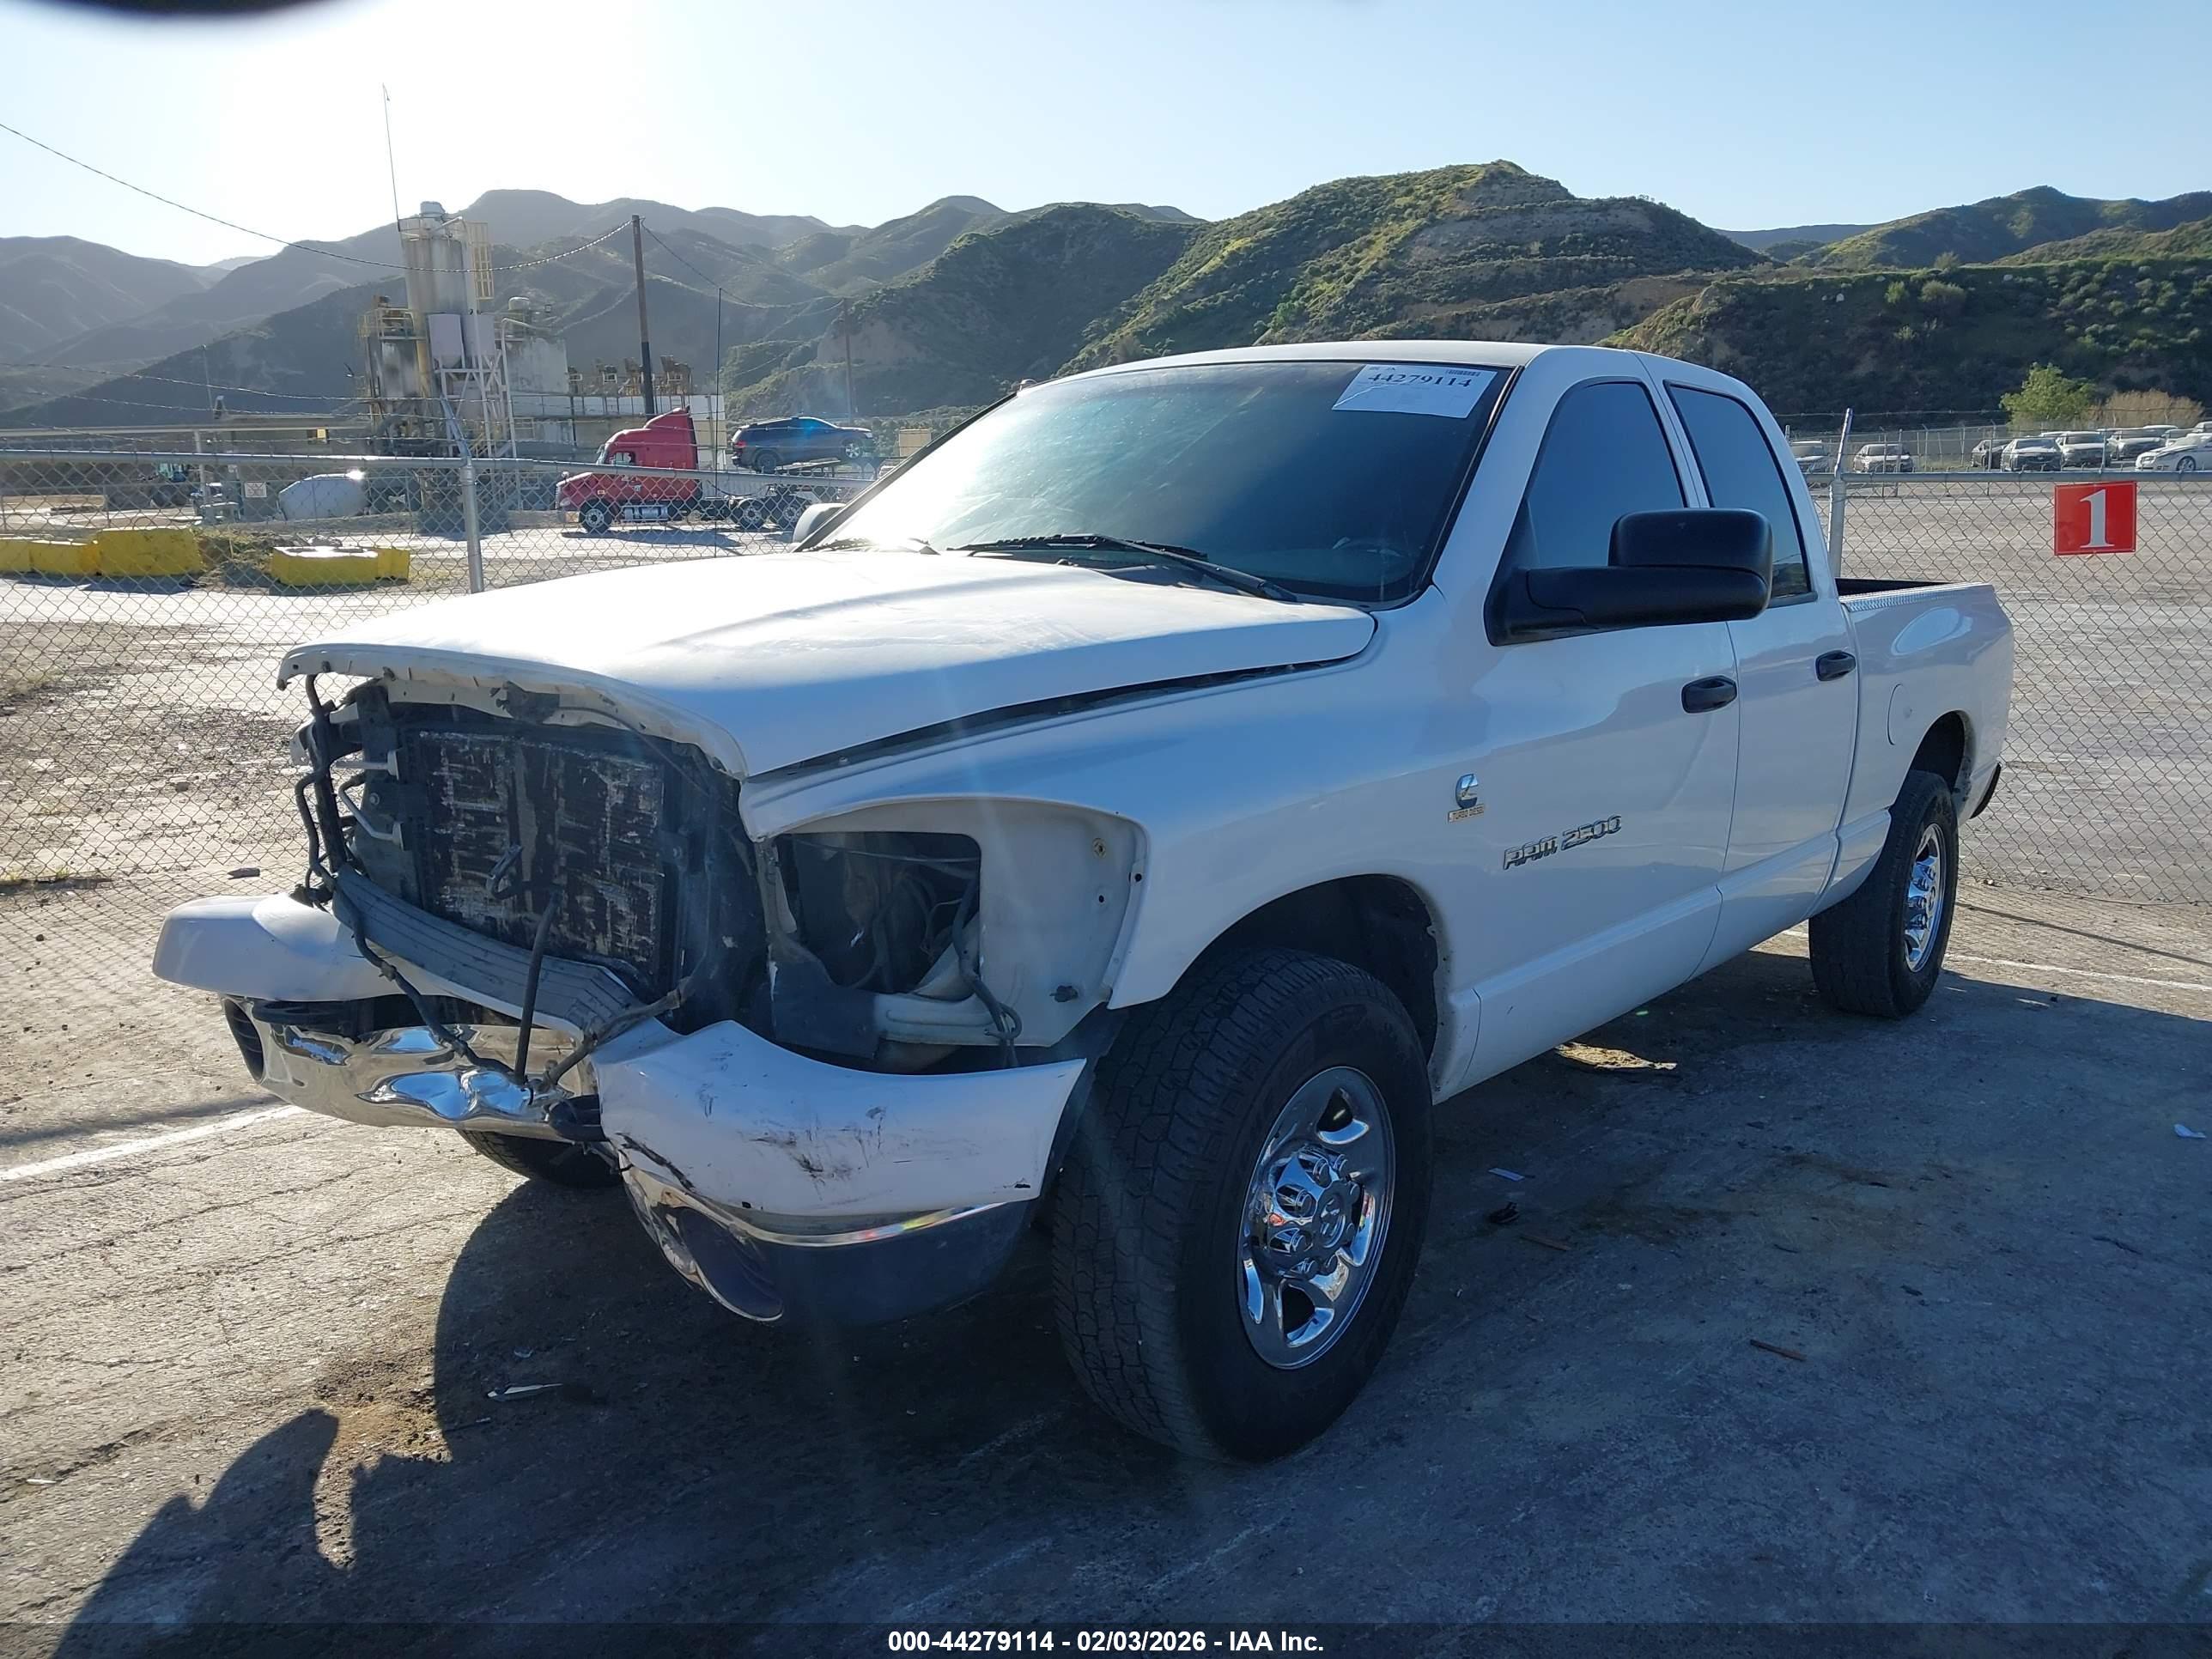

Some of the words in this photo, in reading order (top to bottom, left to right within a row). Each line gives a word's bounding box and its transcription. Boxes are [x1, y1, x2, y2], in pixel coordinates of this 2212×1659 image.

[1367, 373, 1473, 387] 44279114
[2079, 489, 2115, 548] 1
[1504, 836, 1559, 870] RAM
[1561, 815, 1622, 851] 2500
